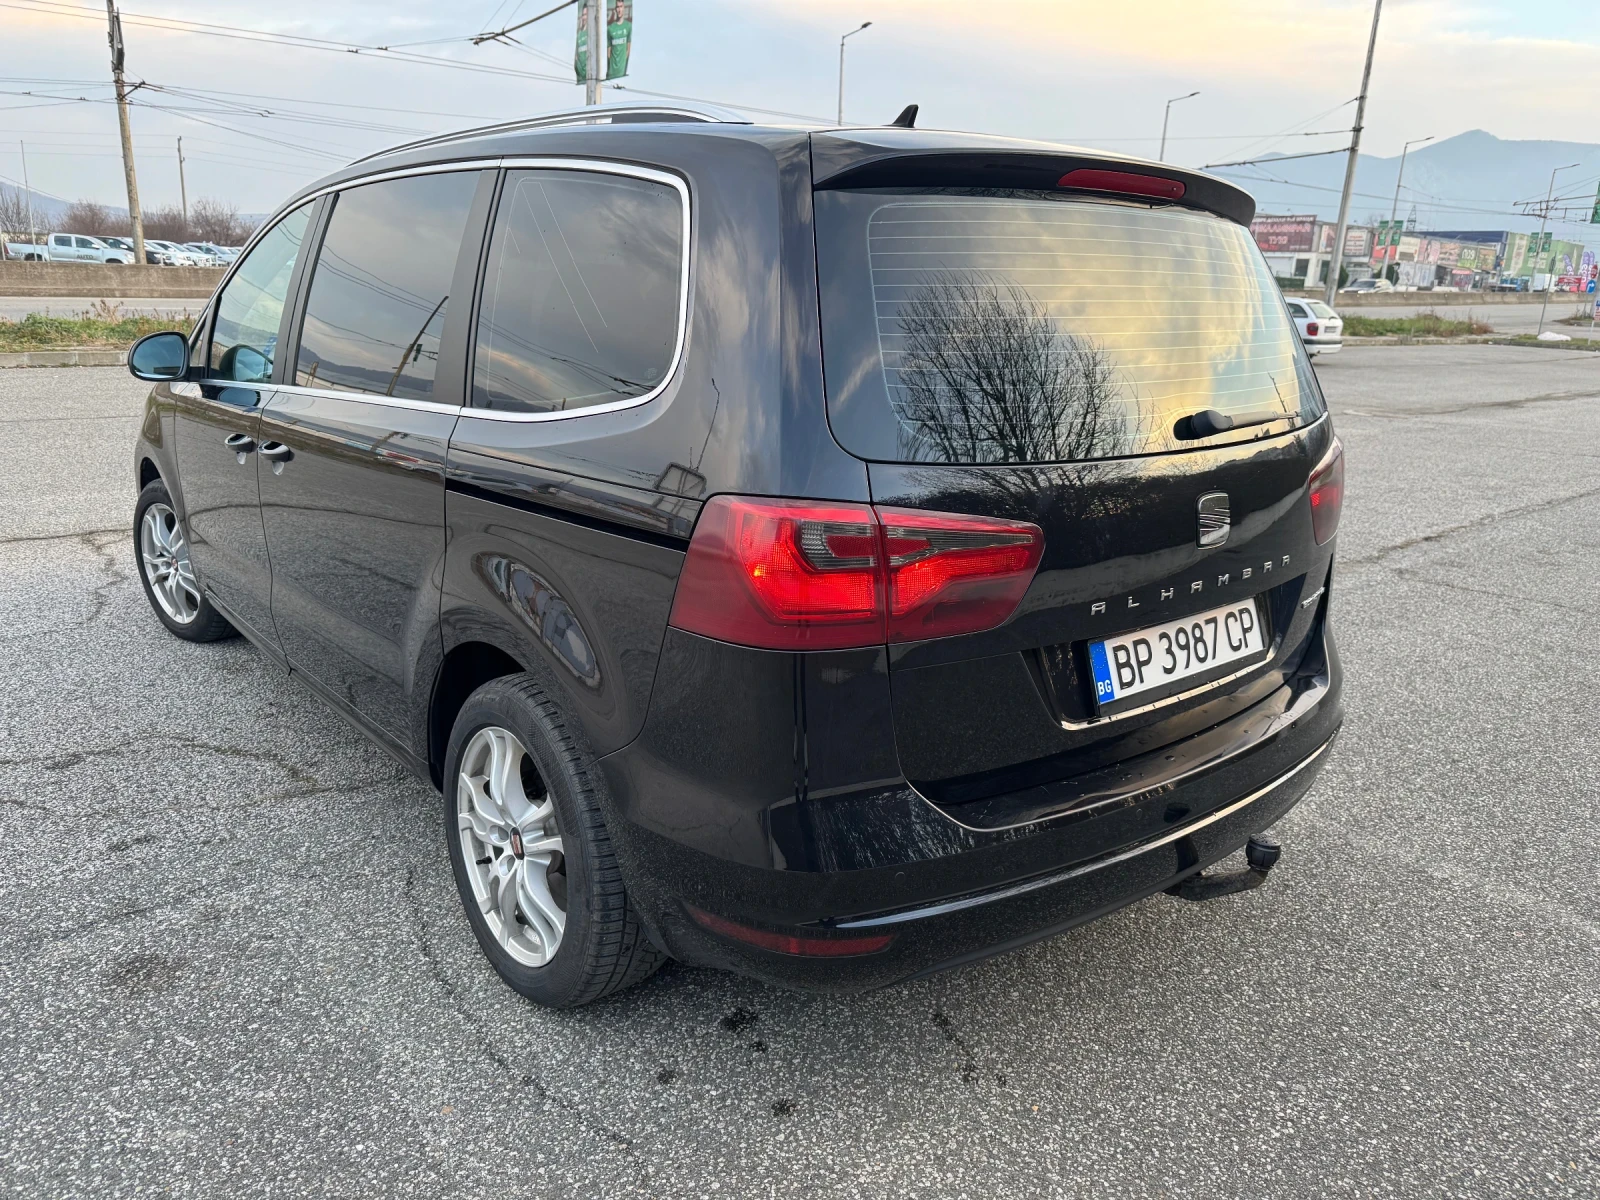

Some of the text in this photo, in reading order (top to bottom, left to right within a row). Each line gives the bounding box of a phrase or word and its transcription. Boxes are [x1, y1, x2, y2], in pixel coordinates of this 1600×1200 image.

[1091, 555, 1290, 616] ALHAMBRA
[1112, 607, 1254, 691] BP 3987 CP
[1098, 680, 1112, 696] BG
